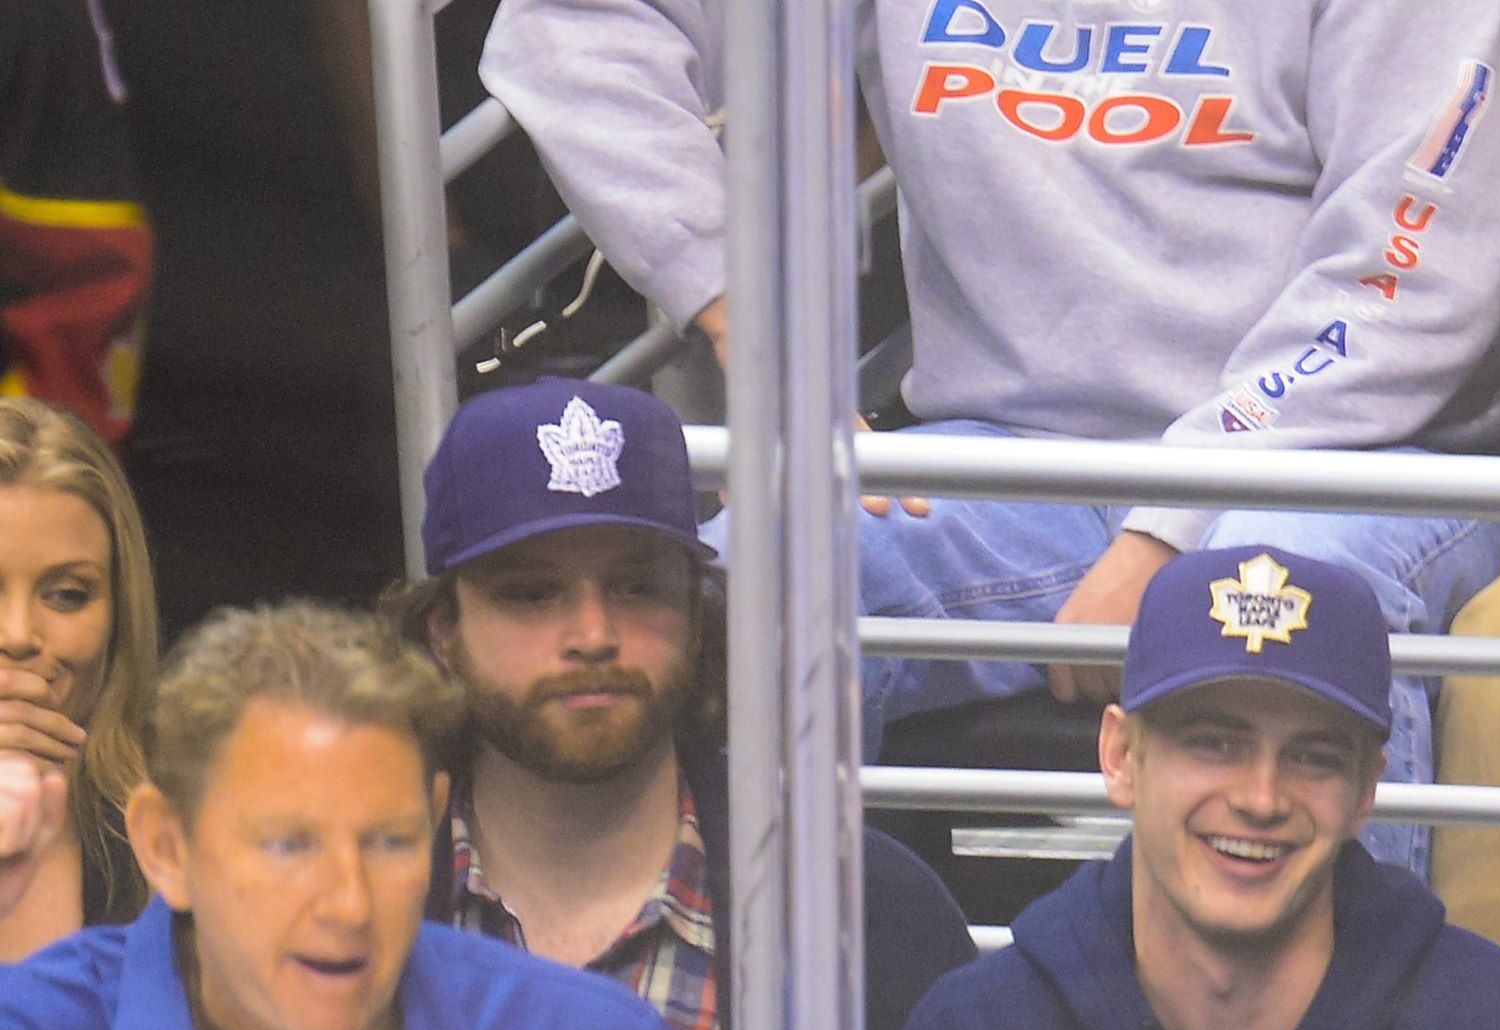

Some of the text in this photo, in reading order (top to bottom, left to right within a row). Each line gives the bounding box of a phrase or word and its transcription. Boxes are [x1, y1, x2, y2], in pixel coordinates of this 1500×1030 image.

[921, 0, 1232, 75] DUEL
[913, 64, 1256, 147] POOL
[1357, 193, 1437, 301] USA
[1226, 593, 1294, 610] TORONTO
